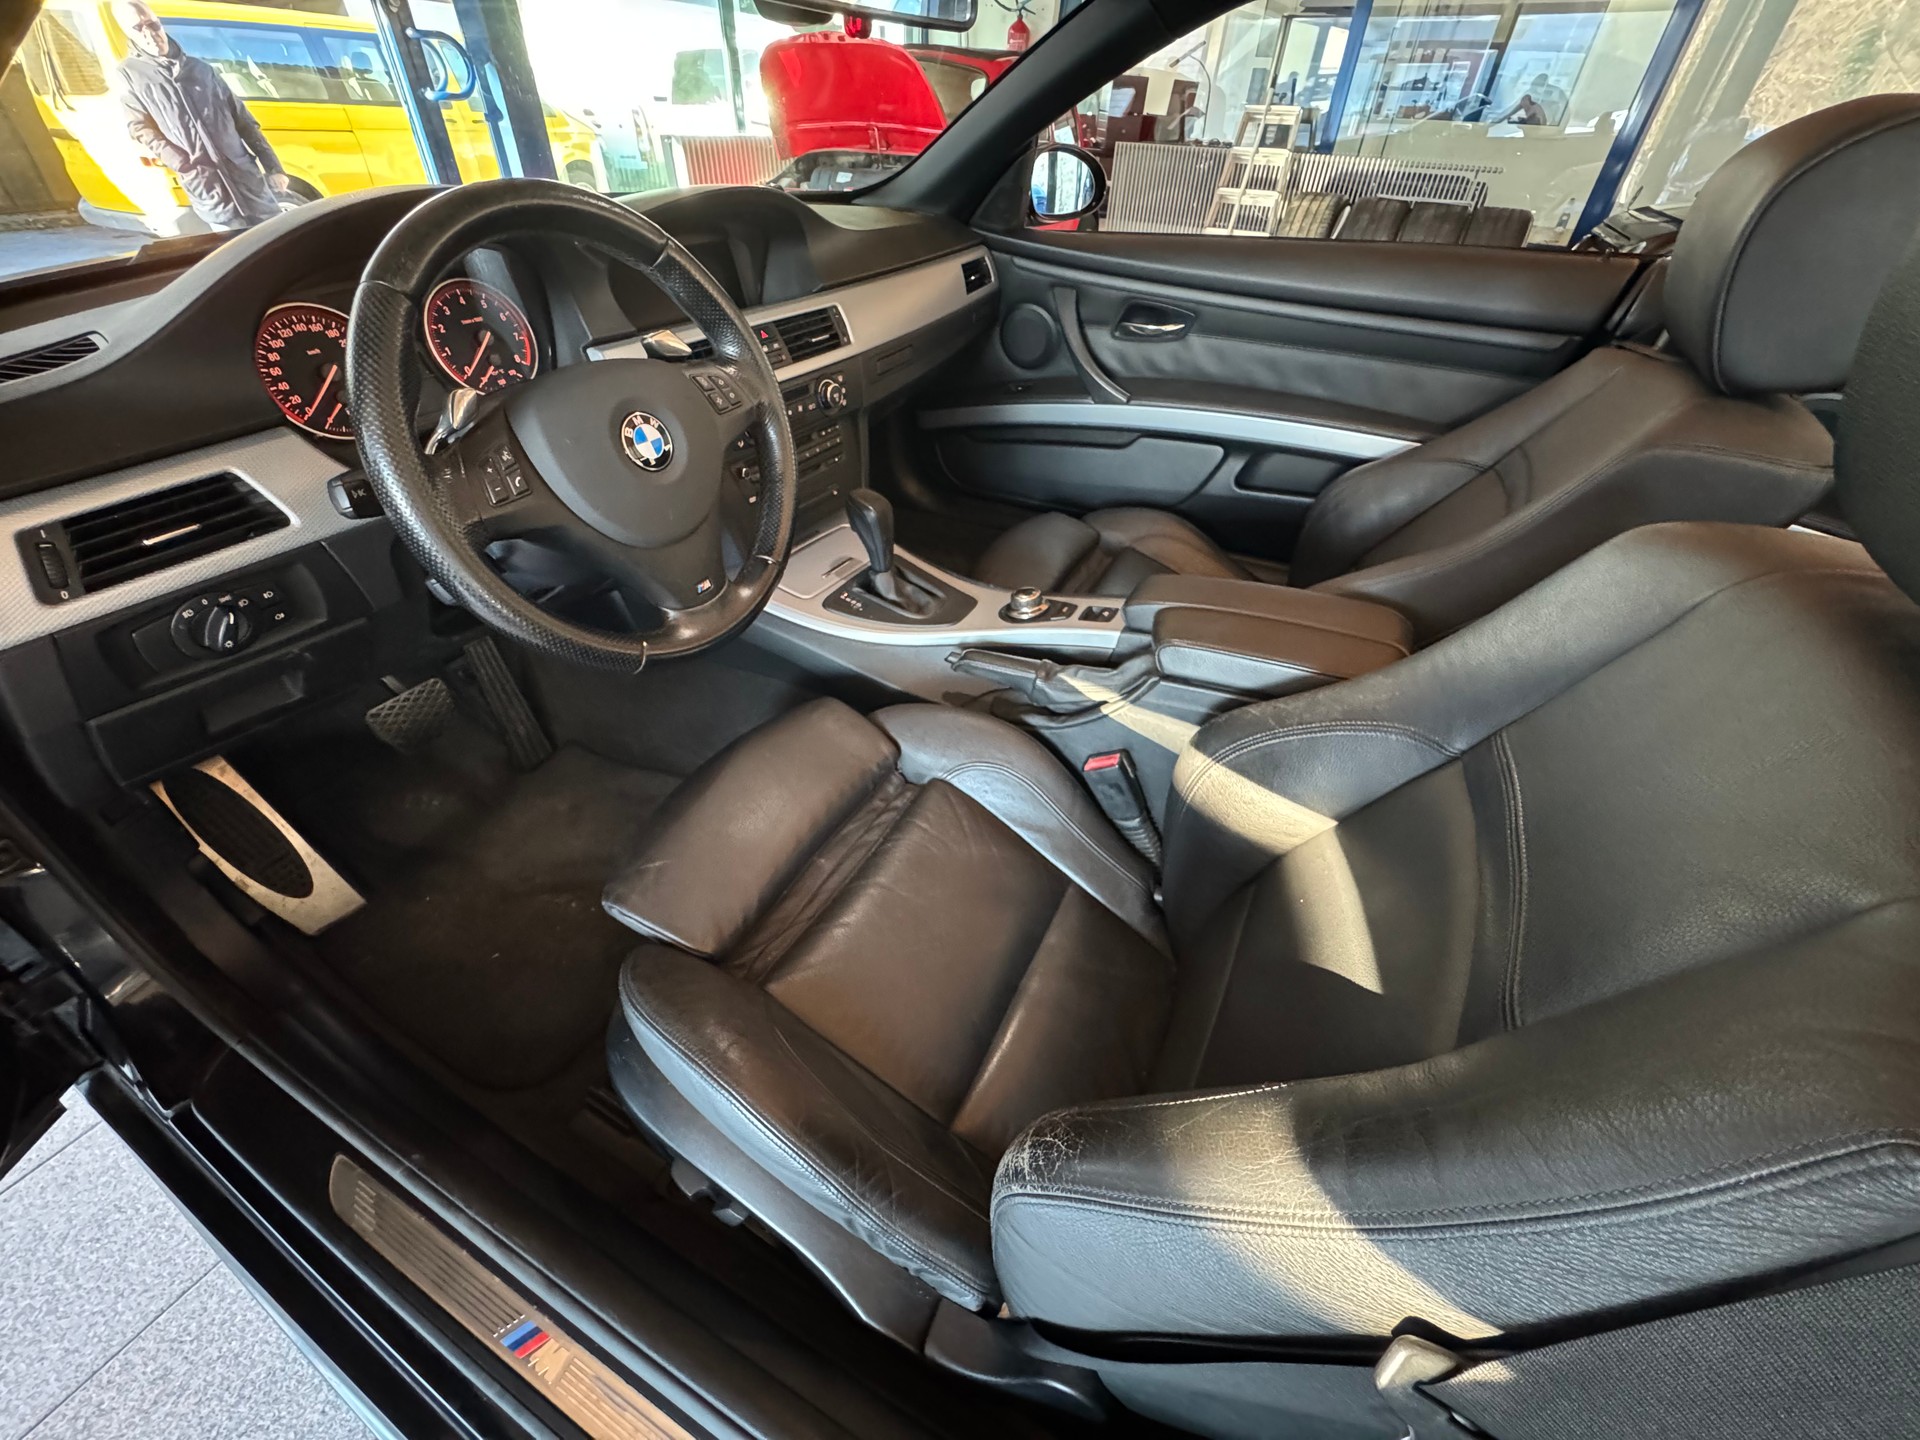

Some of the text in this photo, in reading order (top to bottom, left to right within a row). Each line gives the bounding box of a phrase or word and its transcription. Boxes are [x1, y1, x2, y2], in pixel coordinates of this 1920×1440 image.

[459, 296, 466, 305] 4
[480, 300, 488, 309] 5
[443, 306, 451, 315] 3
[499, 312, 507, 321] 6
[292, 323, 308, 332] 140
[308, 323, 323, 333] 160
[438, 324, 446, 333] 2
[278, 328, 294, 338] 120
[325, 328, 340, 338] 180
[513, 332, 519, 341] 7
[268, 339, 286, 348] 100
[445, 346, 452, 355] 1
[267, 352, 281, 361] 80
[514, 354, 521, 363] 8
[269, 366, 283, 376] 60
[278, 381, 290, 391] 40
[289, 395, 302, 404] 20
[624, 415, 660, 439] BMW
[60, 590, 69, 600] 0
